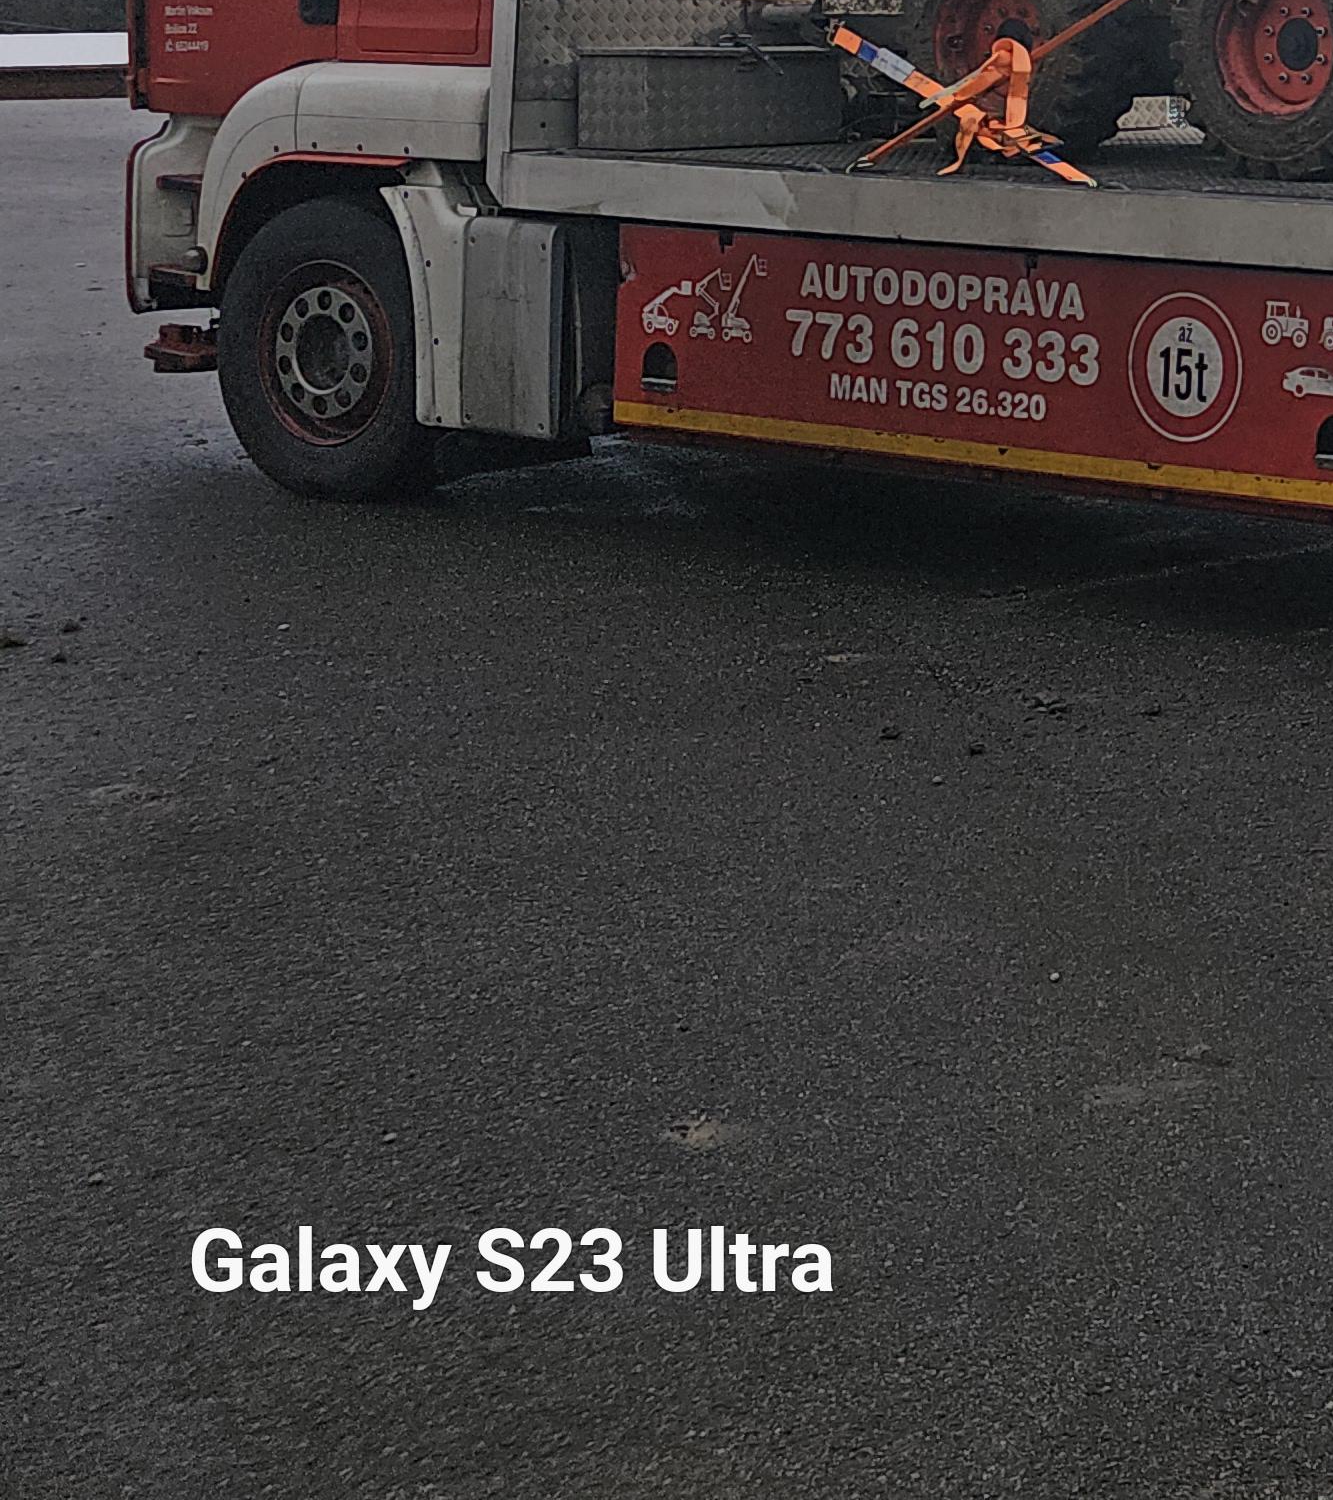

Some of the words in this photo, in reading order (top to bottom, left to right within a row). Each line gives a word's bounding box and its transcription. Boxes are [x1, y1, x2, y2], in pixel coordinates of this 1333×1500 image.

[800, 261, 1085, 321] AUTODOPRAVA
[785, 308, 873, 364] 773
[891, 318, 985, 375] 610
[1002, 327, 1100, 386] 333
[1178, 322, 1194, 344] až
[830, 373, 887, 405] MAN
[896, 380, 949, 411] TGS
[956, 386, 1047, 421] 26.320
[1159, 346, 1209, 403] 15t
